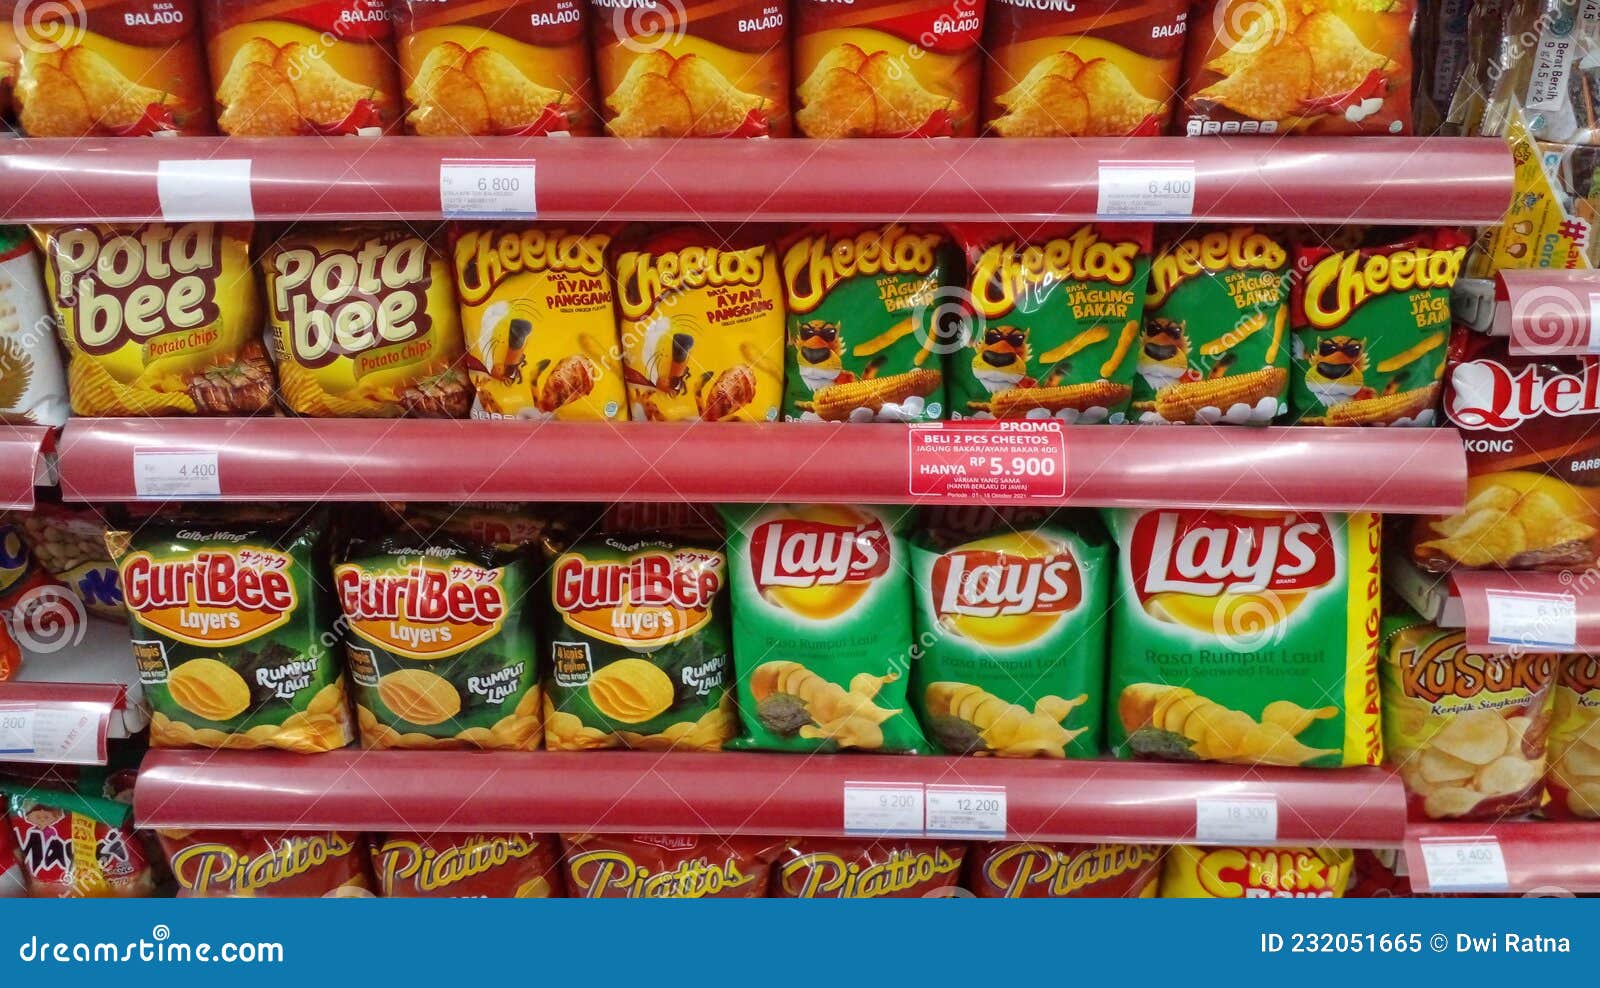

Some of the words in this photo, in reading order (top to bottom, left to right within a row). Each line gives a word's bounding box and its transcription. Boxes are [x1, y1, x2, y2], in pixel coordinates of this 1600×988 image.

[124, 11, 183, 26] BALADO
[341, 10, 391, 22] BALADO
[531, 10, 580, 26] BALADO
[738, 14, 783, 32] BALADO
[933, 18, 979, 34] BALADO
[1552, 42, 1569, 68] Berat
[1547, 70, 1563, 100] Bersih
[57, 223, 214, 298] Pota
[456, 229, 612, 303] Cheetos
[783, 227, 943, 310] Cheetos
[972, 224, 1141, 317] Cheetos
[1146, 227, 1287, 308] heetos
[276, 238, 429, 312] Pota
[557, 280, 603, 294] AYAM
[617, 246, 766, 318] Cheetos
[876, 276, 899, 287] RASA
[1065, 283, 1088, 293] RASA
[78, 275, 206, 346] bee
[546, 291, 613, 309] PANGGANG
[717, 289, 762, 308] AYAM
[885, 293, 934, 312] BAKAR
[1067, 290, 1135, 306] JAGUNG
[1073, 303, 1129, 319] BAKAR
[1234, 289, 1280, 308] BAKAR
[706, 299, 774, 324] PANGGANG
[293, 290, 418, 360] bee
[150, 335, 186, 357] Potato
[188, 328, 219, 350] Chips
[361, 349, 400, 371] Potato
[402, 339, 432, 360] Chips
[924, 435, 950, 444] BELI
[953, 435, 962, 444] 2
[965, 435, 988, 444] PCS
[991, 435, 1048, 445] CHEETOS
[1000, 422, 1060, 432] PROMO
[917, 445, 951, 453] JAGUNG
[953, 445, 1009, 453] BAKAR/AYAM
[920, 464, 967, 475] HANYA
[970, 457, 986, 467] RP
[990, 457, 1056, 476] 5.900
[176, 530, 211, 541] Calbee
[212, 531, 247, 543] Wings
[606, 538, 640, 552] Calbee
[425, 546, 457, 559] Wings
[760, 524, 882, 588] Lay's
[1144, 511, 1322, 597] Lay's
[124, 553, 292, 610] GuriBee
[451, 566, 498, 583] サクサク
[557, 555, 719, 608] GuriBee
[941, 555, 1073, 617] Lay's
[338, 567, 502, 621] GuriBee
[180, 609, 240, 635] Layers
[391, 622, 452, 648] Layers
[611, 609, 674, 635] Layers
[682, 655, 727, 685] RUMPUT
[1146, 651, 1192, 665] Rasa
[1200, 650, 1276, 668] Rumput
[1282, 650, 1325, 664] Laut
[256, 658, 319, 689] RUMPUT
[467, 662, 525, 696] RUMPUT
[696, 673, 723, 696] LAUT
[275, 676, 311, 699] LAUT
[485, 680, 519, 704] LAUT
[1431, 704, 1475, 715] Keripik
[1478, 695, 1532, 710] Singkong
[172, 831, 354, 893] Piattos
[381, 833, 540, 896] Piattos
[569, 850, 755, 897] Piattos
[781, 846, 962, 897] Piattos
